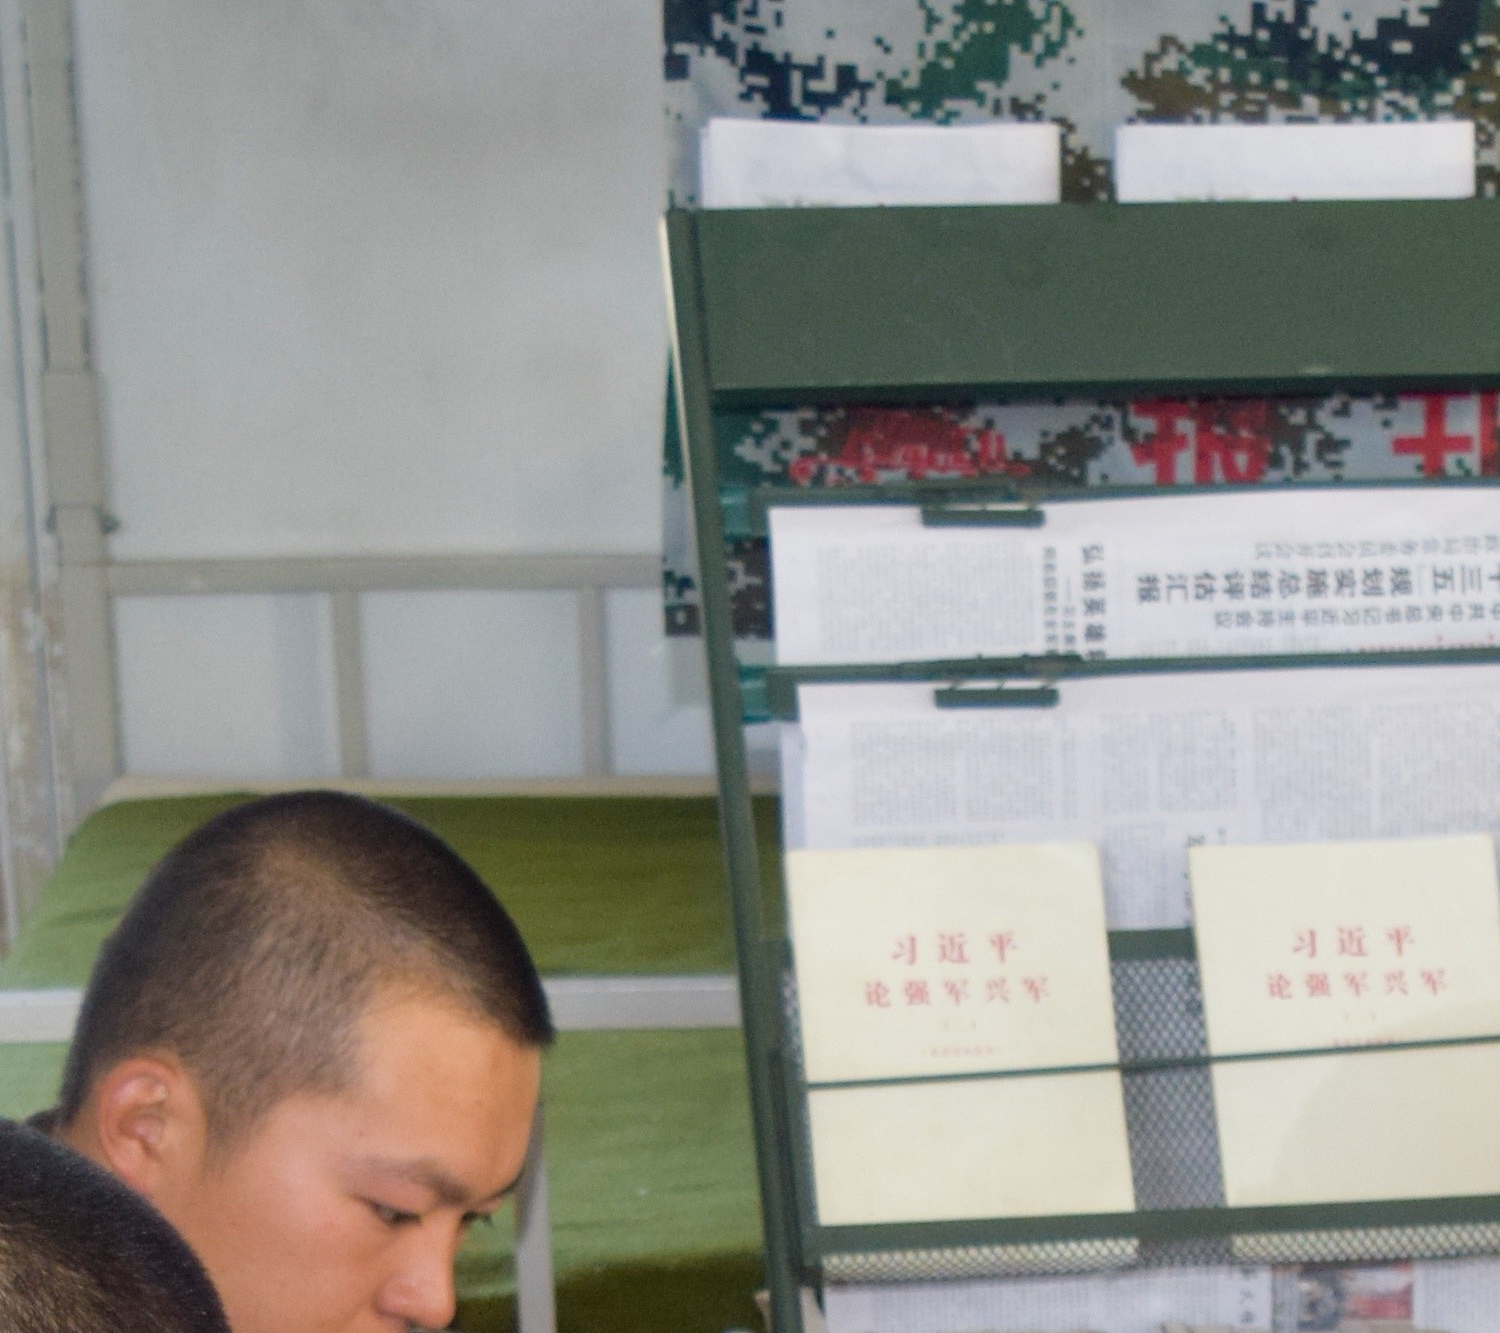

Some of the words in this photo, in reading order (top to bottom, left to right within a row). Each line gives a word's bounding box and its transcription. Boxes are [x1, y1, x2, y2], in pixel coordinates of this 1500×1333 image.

[890, 930, 1017, 965] 习近平
[1292, 925, 1415, 959] 习近平
[864, 975, 1049, 1008] 论强军兴军
[1266, 967, 1446, 999] 论强军兴军
